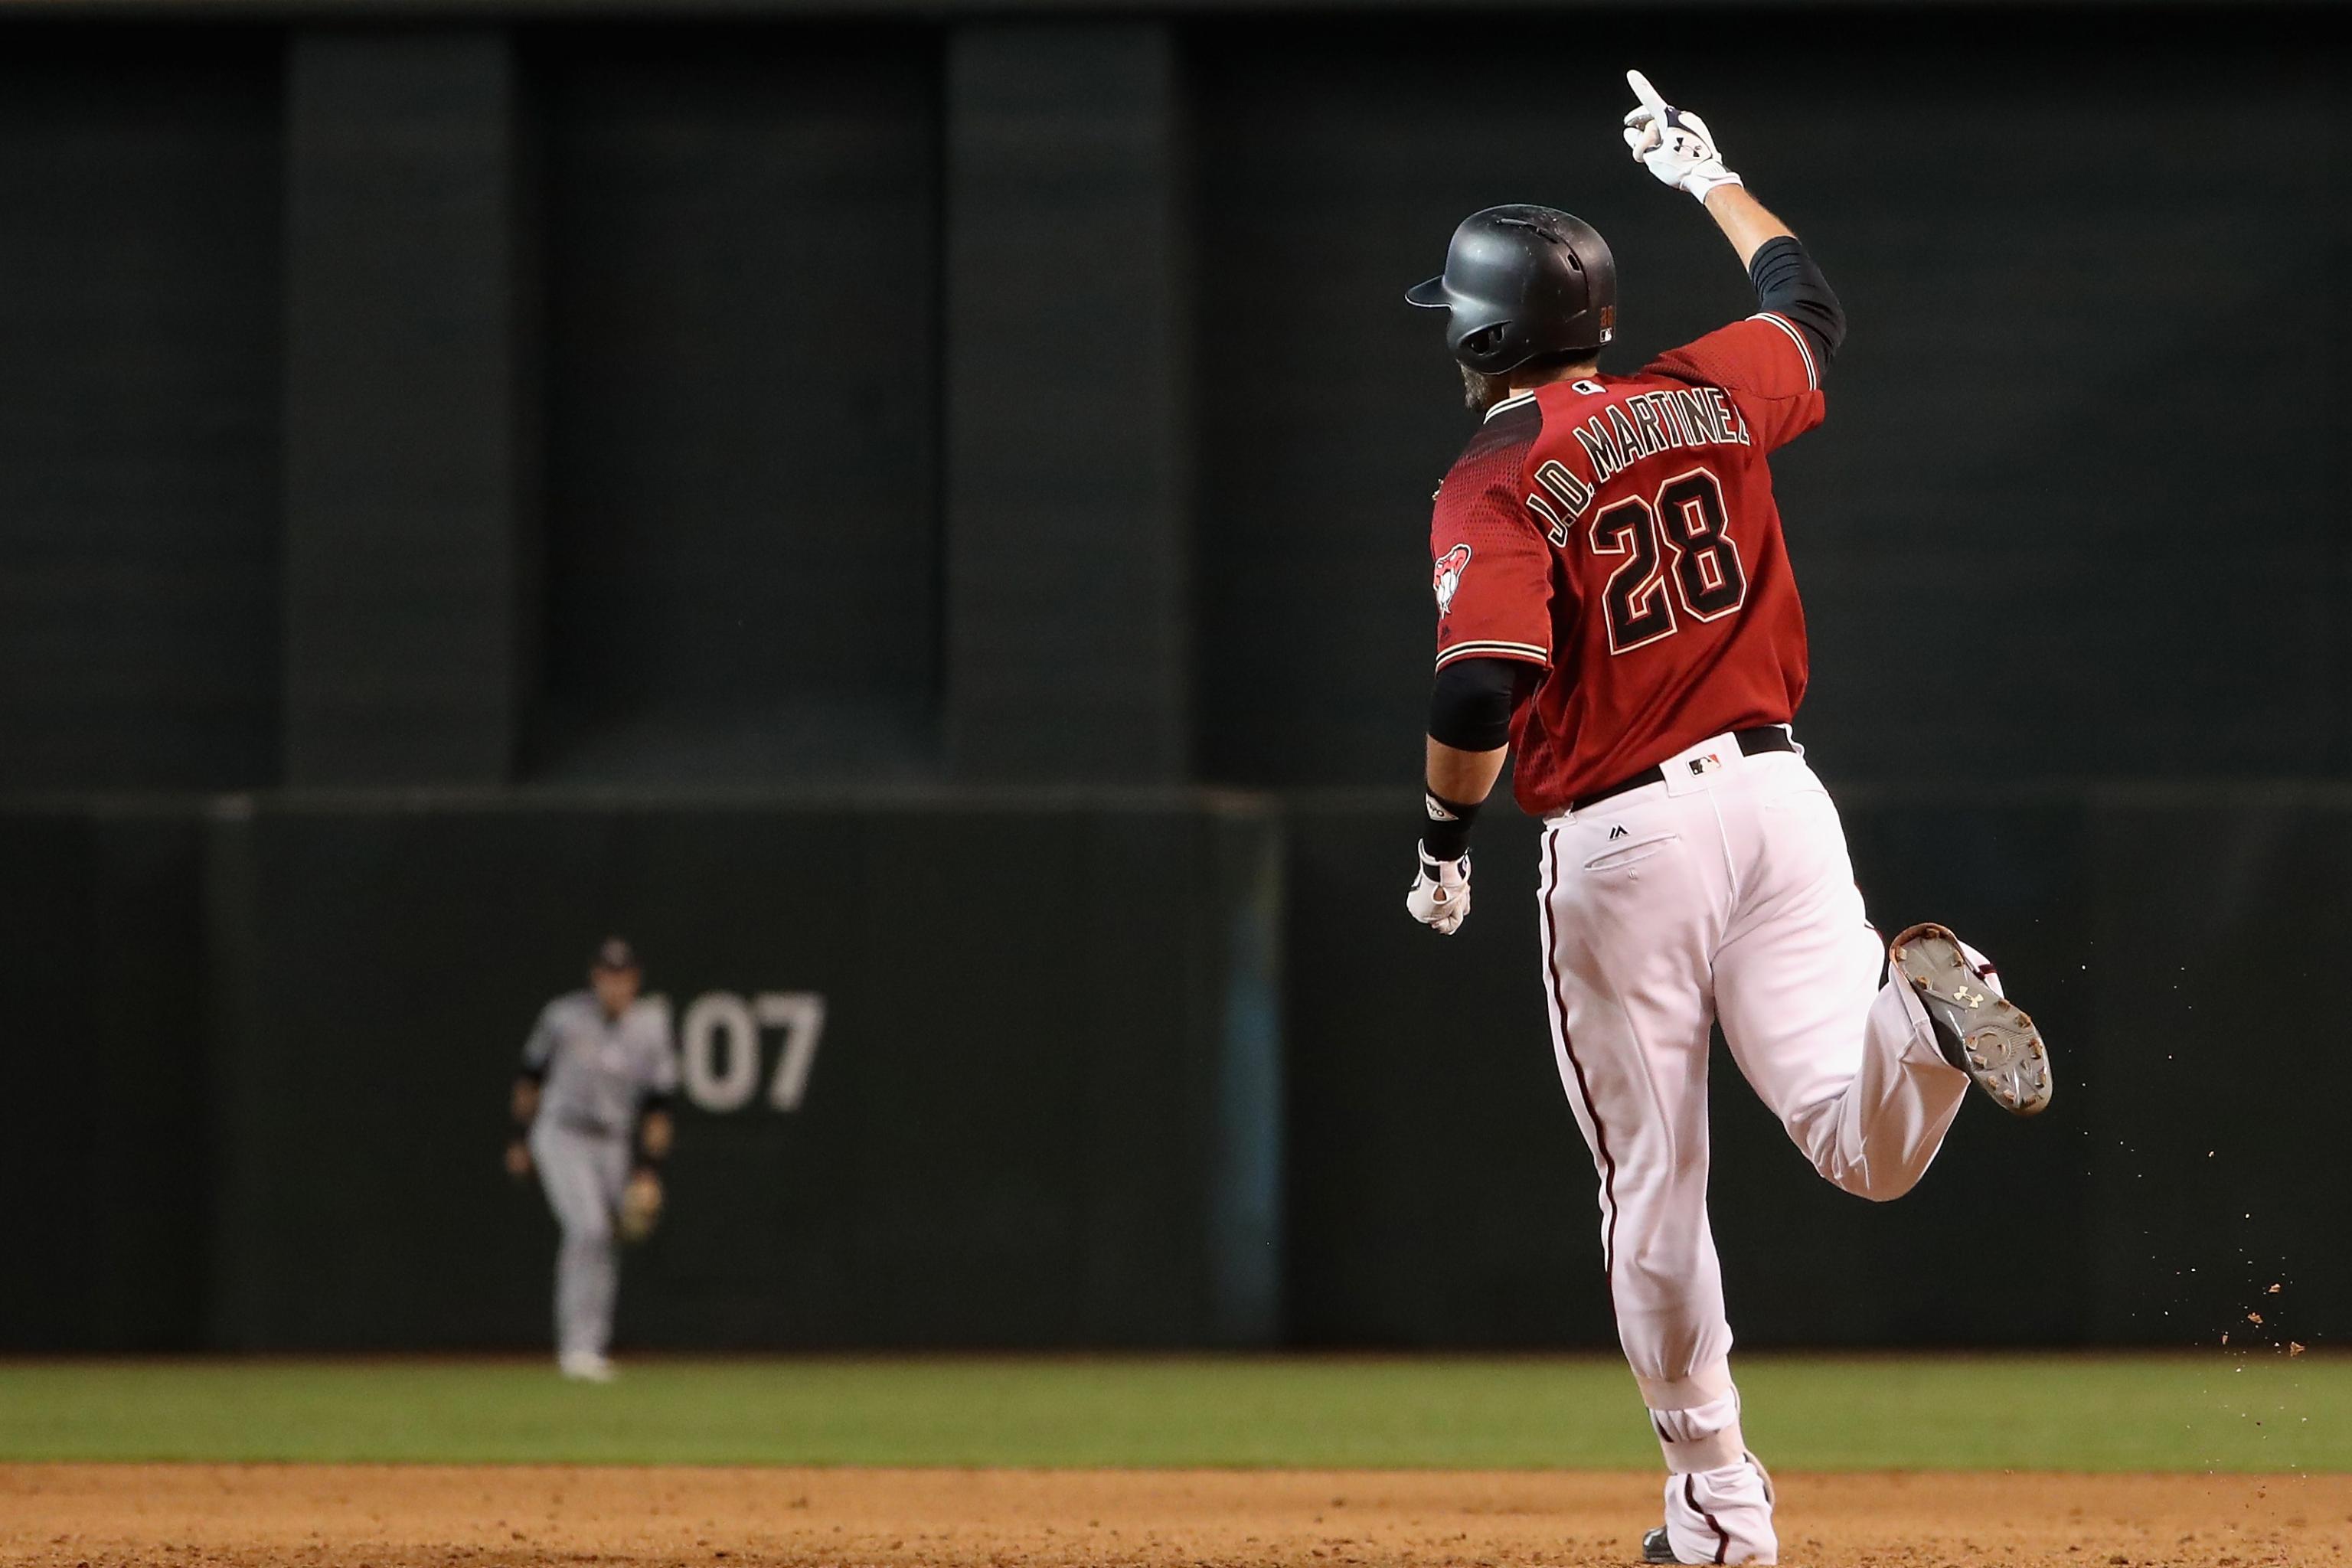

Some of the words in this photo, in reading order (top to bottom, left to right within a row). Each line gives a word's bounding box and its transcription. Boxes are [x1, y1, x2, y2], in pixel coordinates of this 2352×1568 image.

[1526, 460, 1595, 548] J.D.
[1589, 466, 1747, 655] 28
[642, 993, 824, 1110] 07
